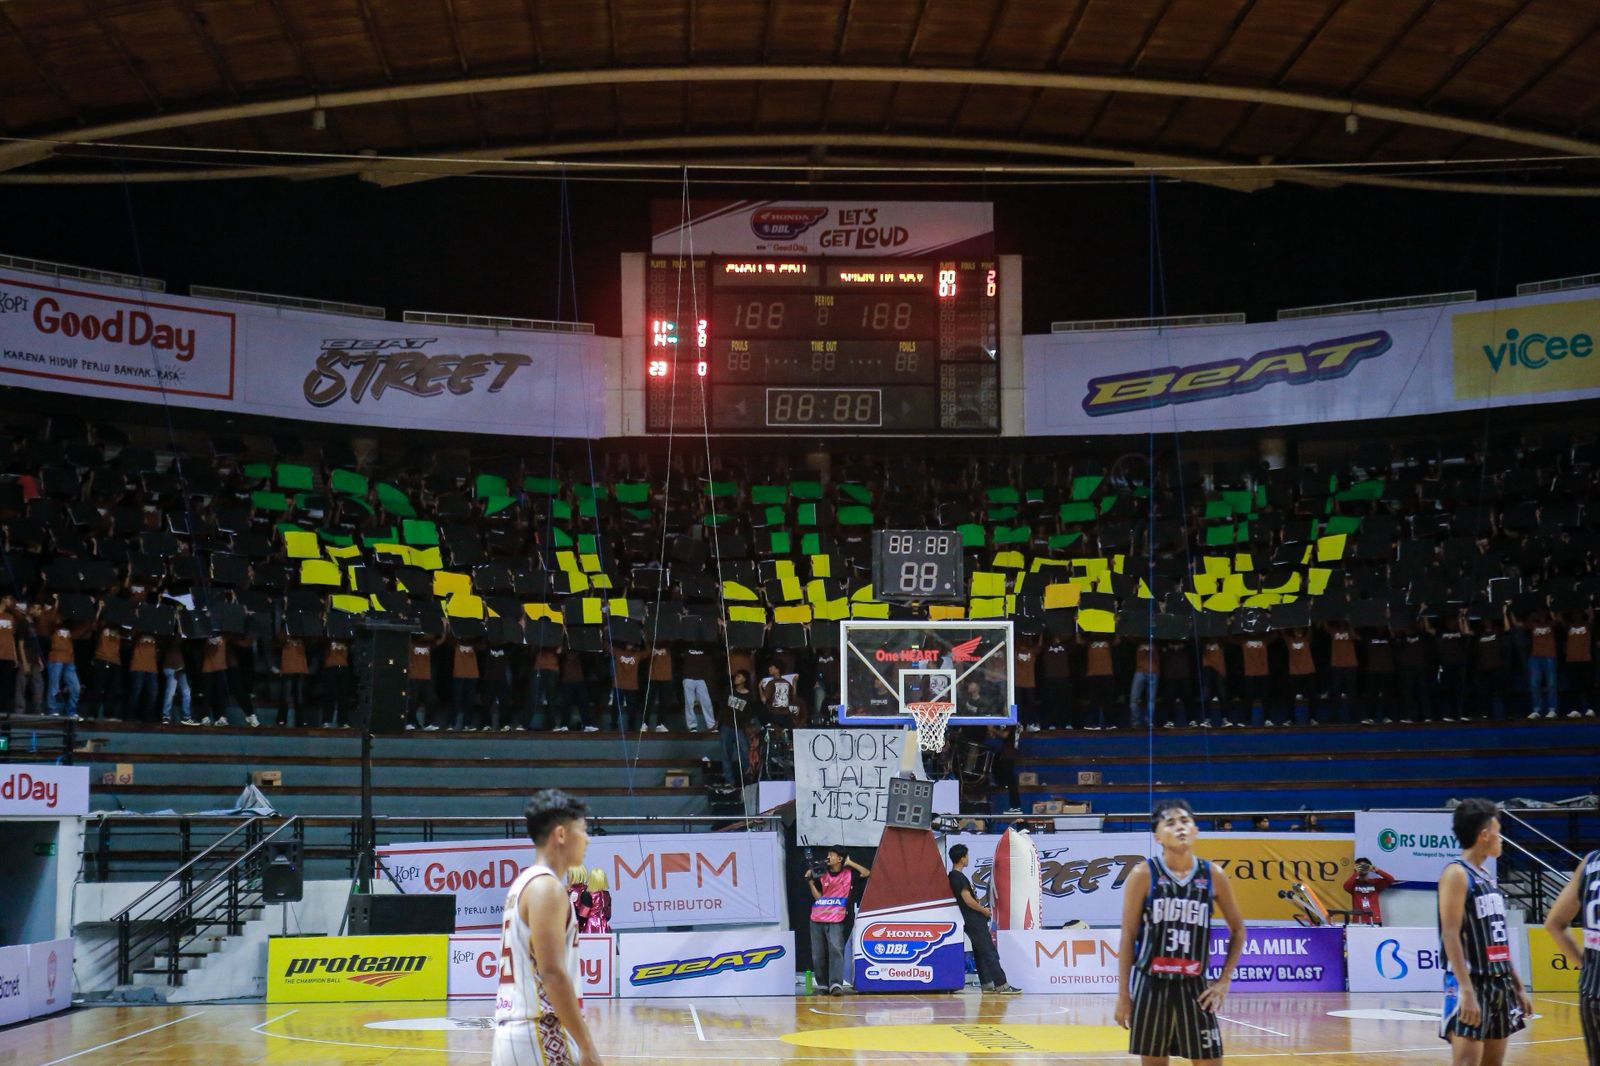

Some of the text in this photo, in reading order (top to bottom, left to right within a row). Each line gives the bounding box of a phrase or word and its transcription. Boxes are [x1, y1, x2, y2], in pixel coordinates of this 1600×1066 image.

[771, 213, 810, 221] HONDA
[838, 207, 878, 226] LET'S
[819, 225, 909, 250] GET LOUD
[731, 340, 749, 352] FOULS
[898, 340, 916, 353] FOULS
[3, 348, 46, 364] KARENA
[49, 355, 78, 369] HIDUP
[81, 359, 111, 372] PERLU
[114, 364, 151, 378] BANYAK
[302, 350, 534, 408] STREET
[875, 649, 940, 662] One HEART
[810, 733, 900, 762] OJOK
[1399, 833, 1416, 848] RS
[613, 851, 738, 892] MPM
[632, 898, 723, 913] DISTRIBUTOR
[814, 898, 842, 906] MEDIA
[464, 906, 488, 916] PERLU
[886, 930, 934, 938] HONDA
[1165, 928, 1191, 954] 34
[885, 943, 910, 955] DBL
[1263, 937, 1309, 956] MILK
[284, 954, 428, 978] proteam
[1278, 965, 1323, 981] BLAST
